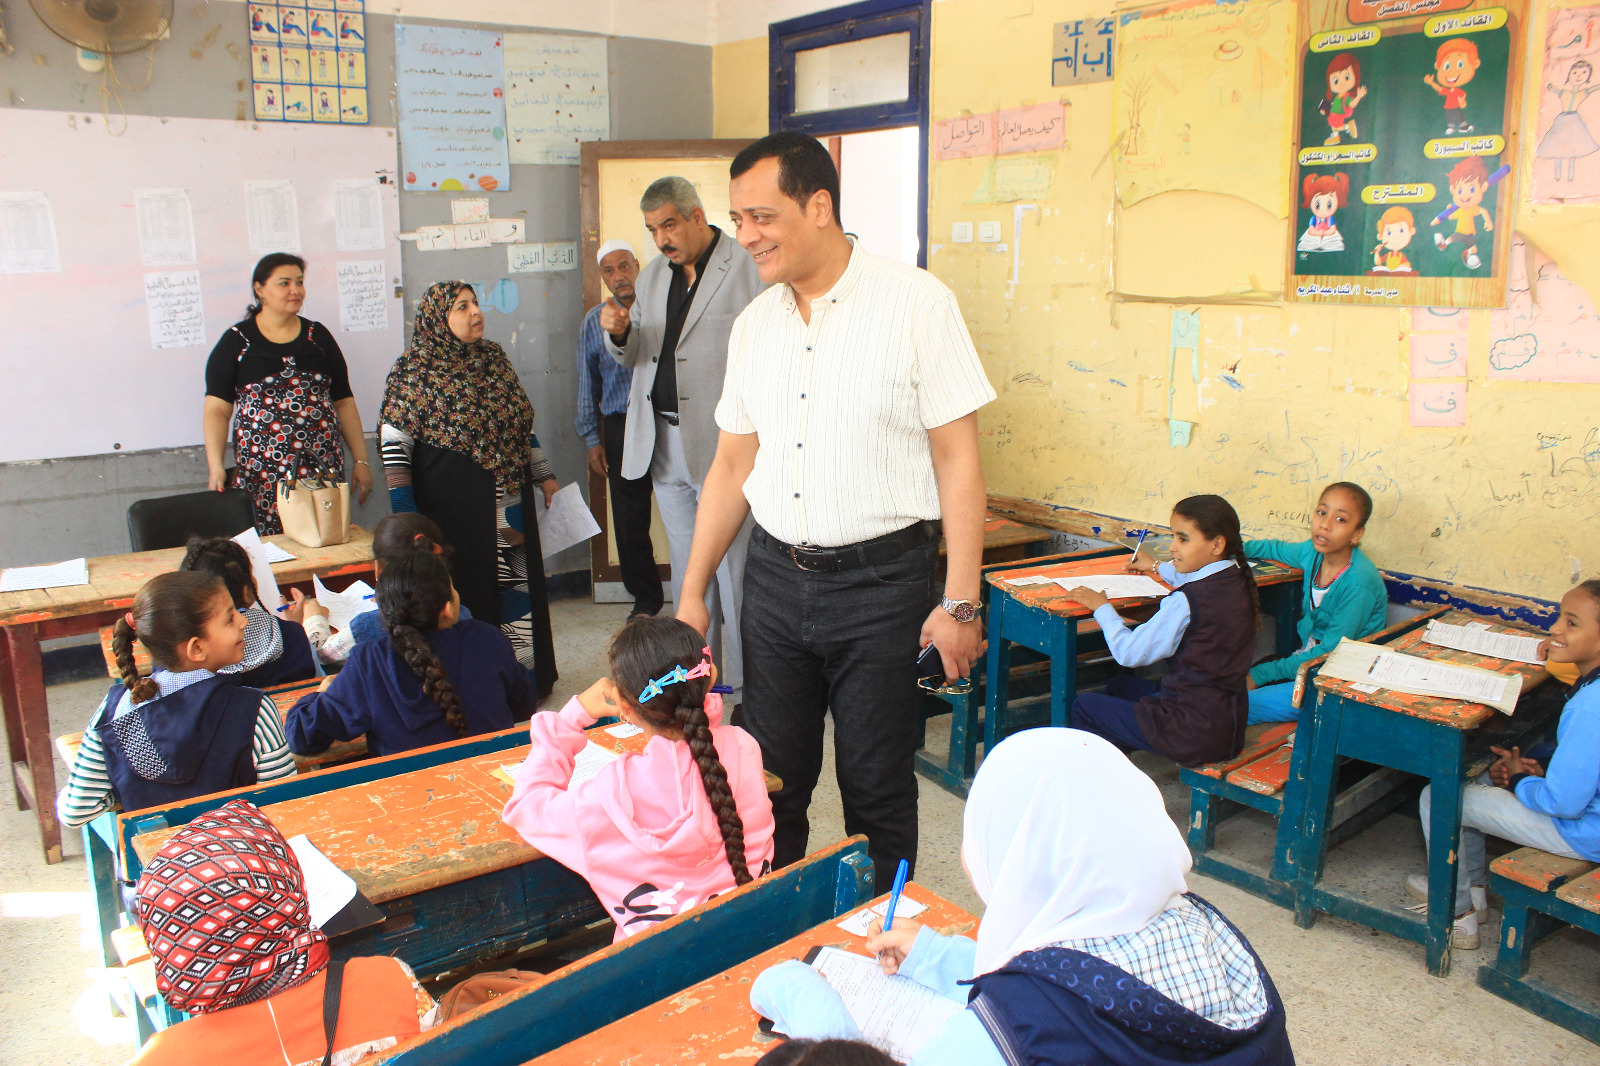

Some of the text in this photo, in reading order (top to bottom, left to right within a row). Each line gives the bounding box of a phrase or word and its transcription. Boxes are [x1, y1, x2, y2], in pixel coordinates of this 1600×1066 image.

[1377, 0, 1440, 17] مجلس الفصل
[1460, 14, 1493, 28] القائد
[1347, 31, 1375, 43] القائد
[1012, 123, 1034, 141] يعمل
[1035, 117, 1061, 134] كيف
[943, 120, 984, 150] التواصل
[1434, 138, 1494, 156] كاتب السبورة
[1301, 151, 1326, 164] الكشكول
[1334, 150, 1354, 163] السجل
[1355, 148, 1372, 161] كاتب
[1297, 283, 1319, 297] الكريم
[1320, 285, 1333, 297] عبد
[1385, 287, 1399, 298] مدير
